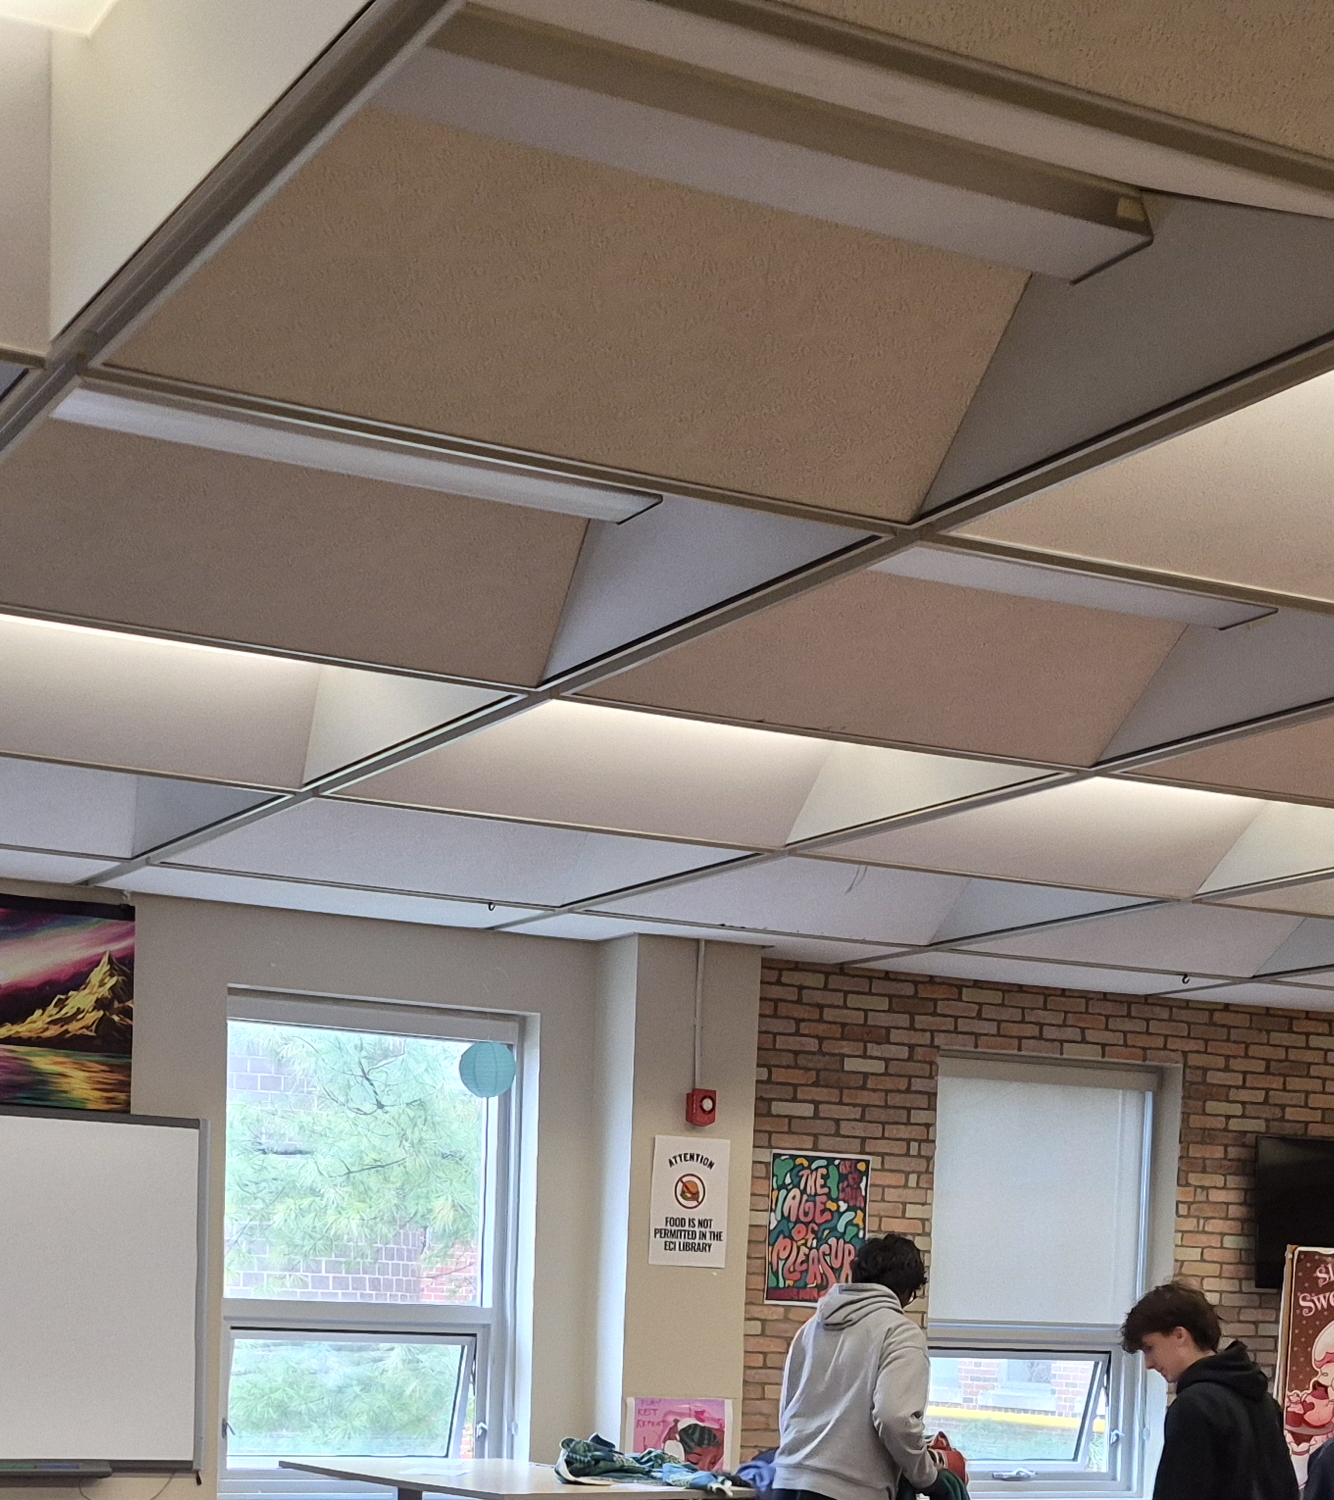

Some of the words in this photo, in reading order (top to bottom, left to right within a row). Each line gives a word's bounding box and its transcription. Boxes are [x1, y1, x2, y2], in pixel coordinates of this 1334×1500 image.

[668, 1152, 716, 1171] ATTENTION
[798, 1168, 829, 1196] THE
[783, 1188, 832, 1224] AGE
[664, 1216, 686, 1228] FOOD
[687, 1217, 696, 1228] IS
[698, 1218, 713, 1229] NOT
[654, 1229, 696, 1241] PERMITTED
[698, 1230, 708, 1241] IN
[709, 1230, 723, 1242] THE
[663, 1240, 677, 1252] ECI
[678, 1241, 713, 1253] LIBRARY
[791, 1223, 819, 1248] OF
[771, 1234, 856, 1291] PLEASUR
